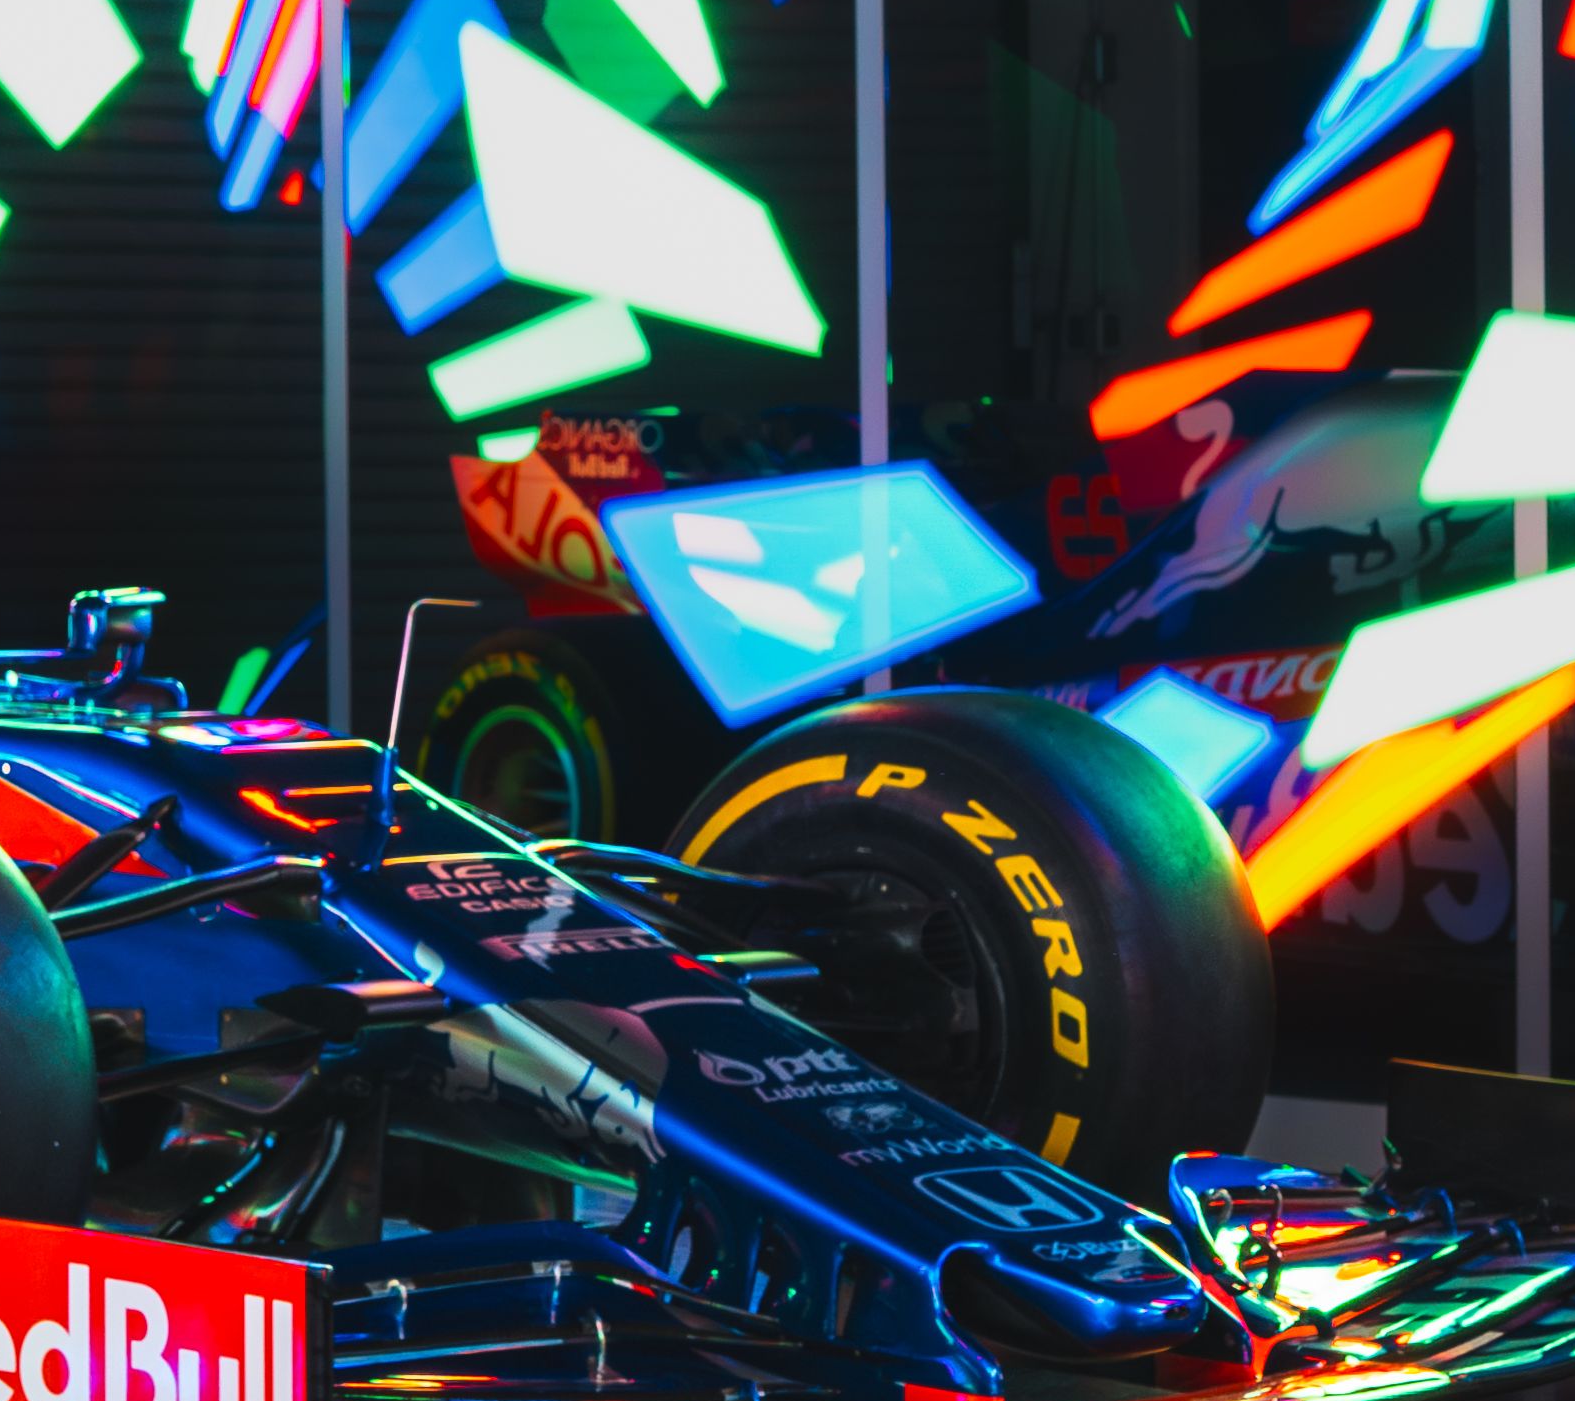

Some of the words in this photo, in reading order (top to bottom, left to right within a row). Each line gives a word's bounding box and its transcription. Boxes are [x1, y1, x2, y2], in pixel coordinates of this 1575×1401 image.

[460, 895, 575, 913] CASIO
[856, 763, 927, 798] P
[942, 800, 1089, 1068] ZERO
[763, 1048, 859, 1083] ptt
[753, 1077, 900, 1103] Lubricants
